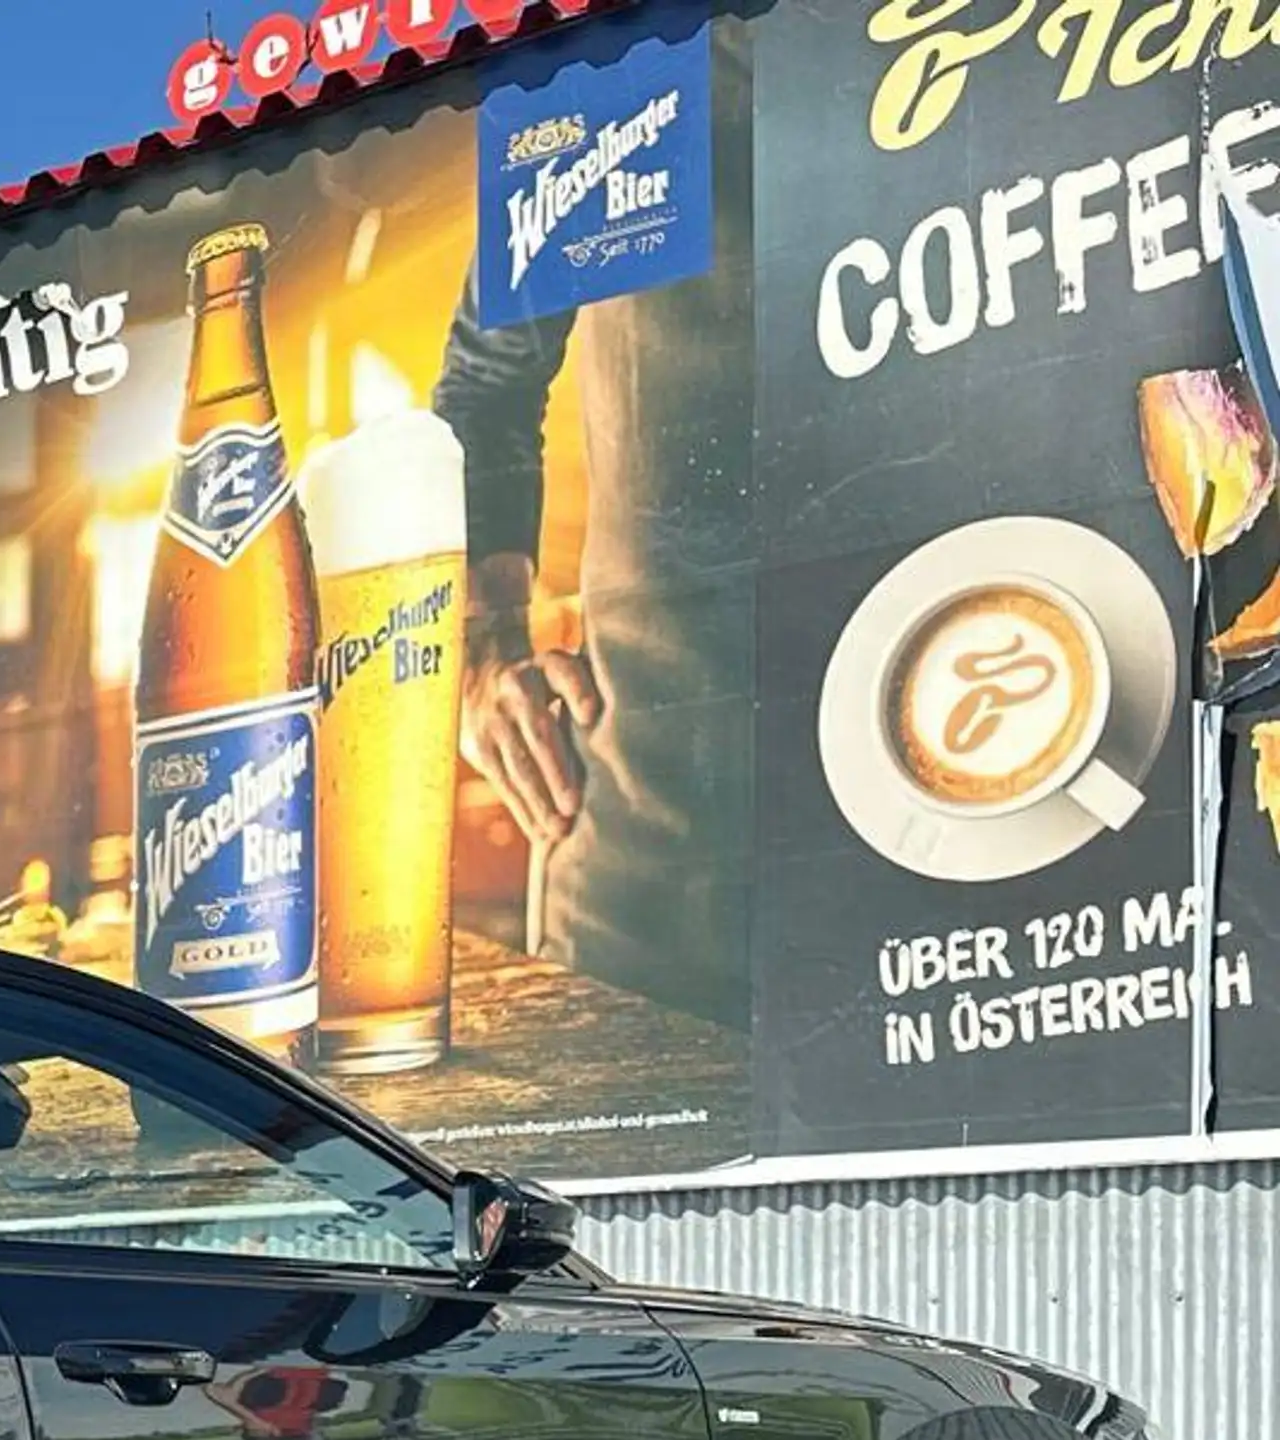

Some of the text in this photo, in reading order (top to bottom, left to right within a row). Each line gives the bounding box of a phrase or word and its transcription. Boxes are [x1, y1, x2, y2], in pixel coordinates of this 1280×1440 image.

[506, 89, 679, 290] Wieselburger Bier
[395, 638, 443, 683] Bier
[145, 734, 309, 950] Wieselburger Bier
[181, 941, 268, 963] GOLD
[878, 927, 1014, 997] ÜBER
[1025, 905, 1105, 968] 120
